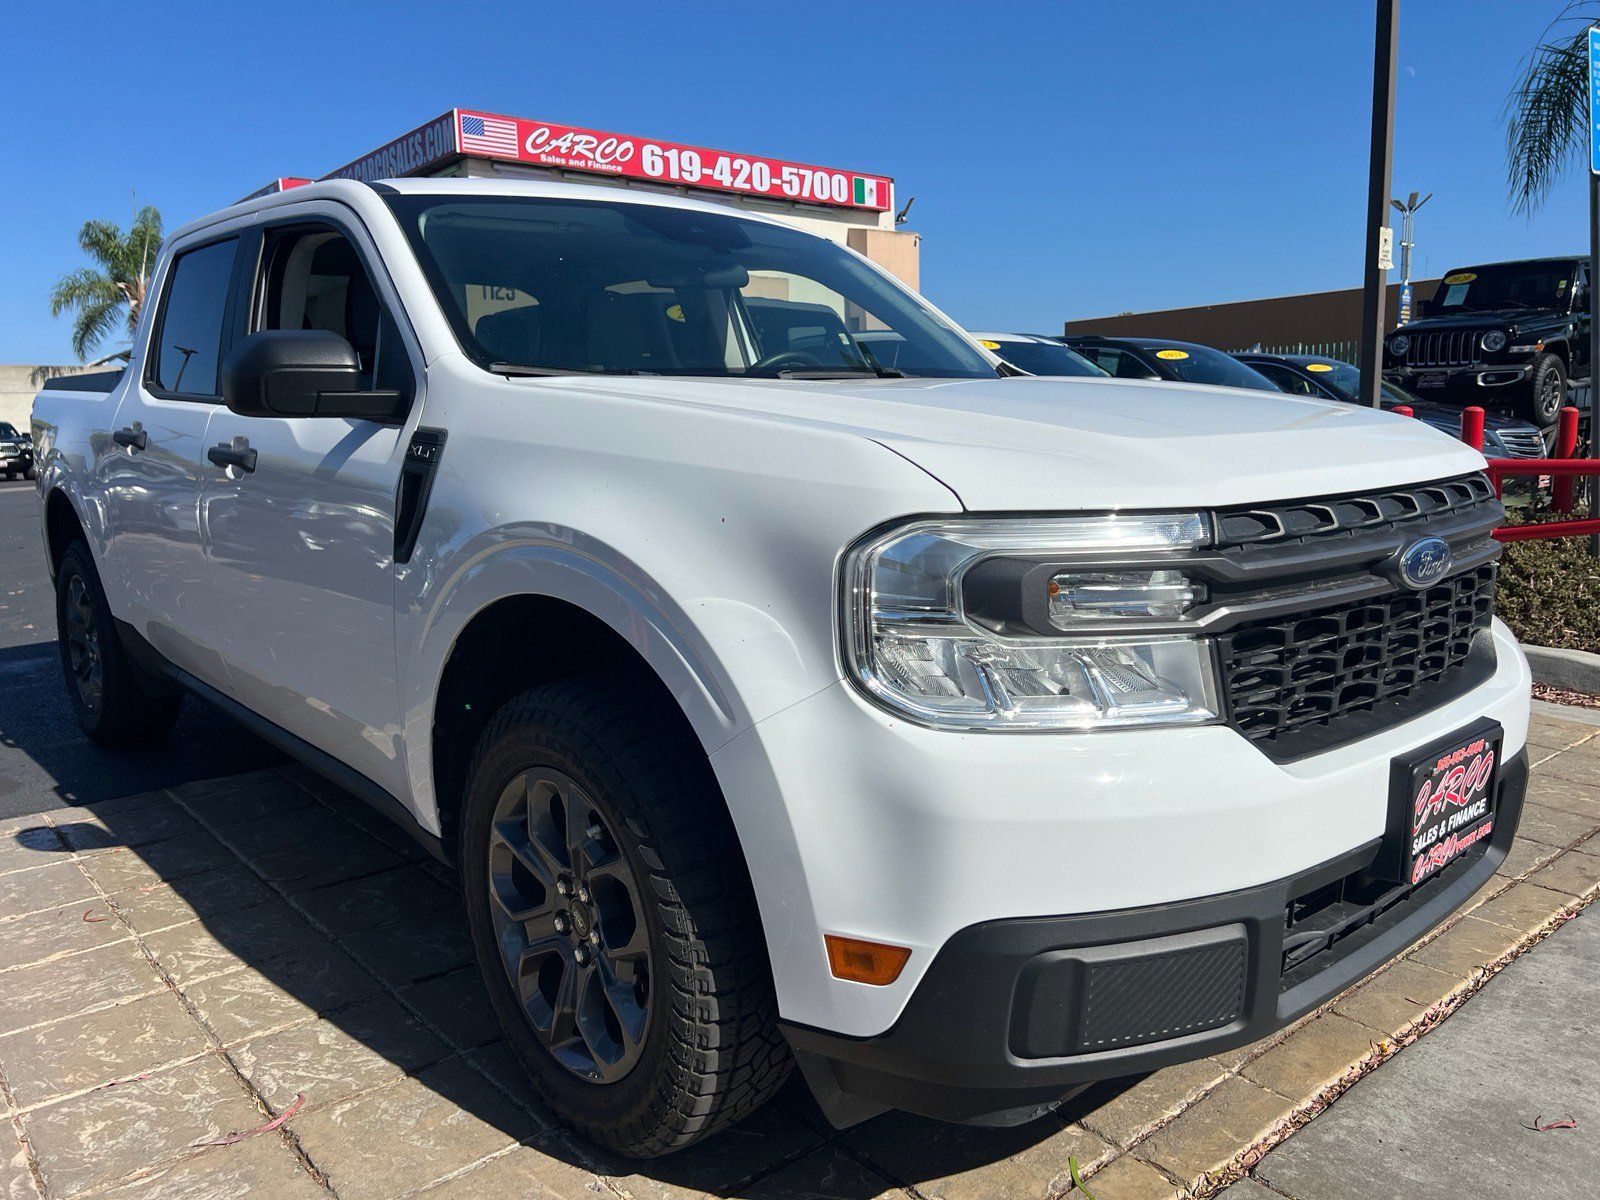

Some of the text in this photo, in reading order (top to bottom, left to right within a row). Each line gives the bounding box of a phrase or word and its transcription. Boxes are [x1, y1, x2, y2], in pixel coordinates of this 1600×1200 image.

[525, 127, 848, 203] CARCO 619-420-5700
[540, 153, 623, 173] Sales and Finance
[408, 445, 435, 458] XLT
[1417, 550, 1446, 578] Ford
[1413, 750, 1493, 836] CARCO
[1412, 797, 1487, 856] SALES & FINANCE
